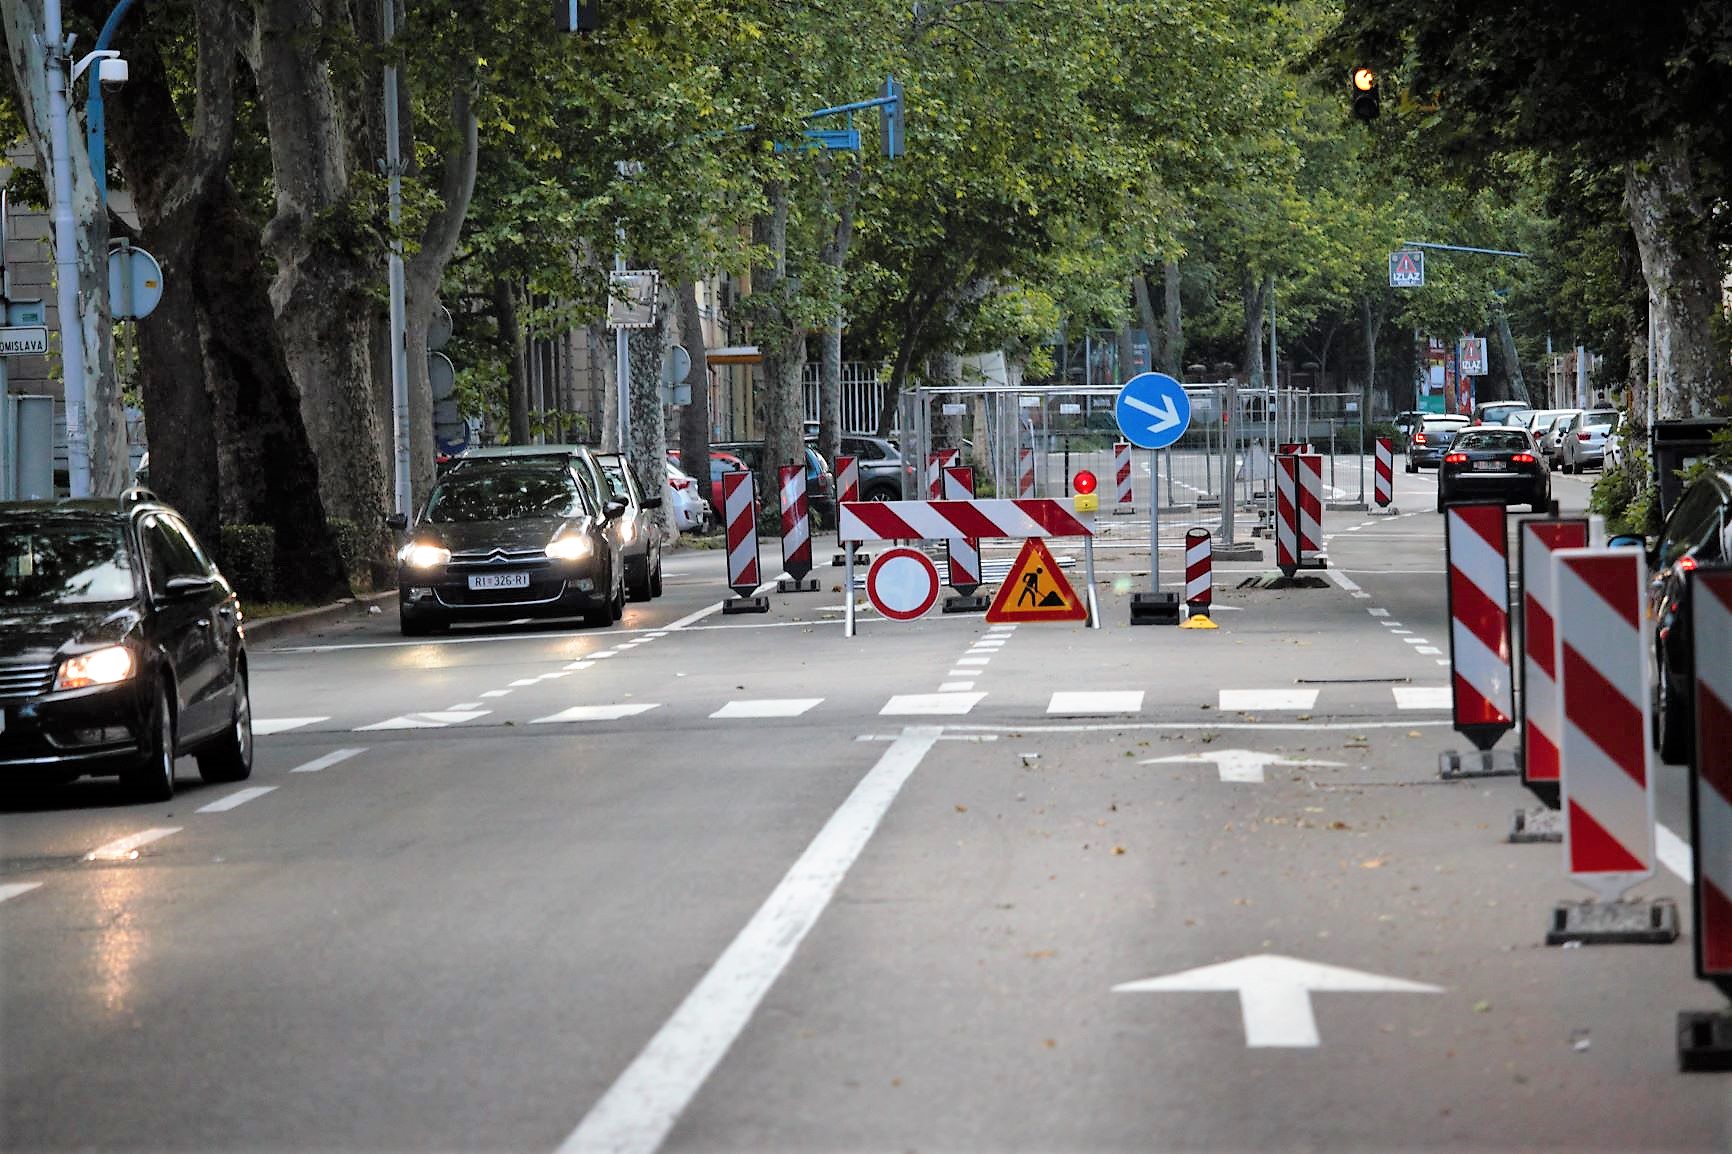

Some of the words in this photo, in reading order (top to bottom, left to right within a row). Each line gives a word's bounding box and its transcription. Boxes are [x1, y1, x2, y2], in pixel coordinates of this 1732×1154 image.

[1393, 272, 1420, 281] IZLAZ
[1462, 360, 1481, 369] IZLAZ
[475, 577, 486, 587] RI
